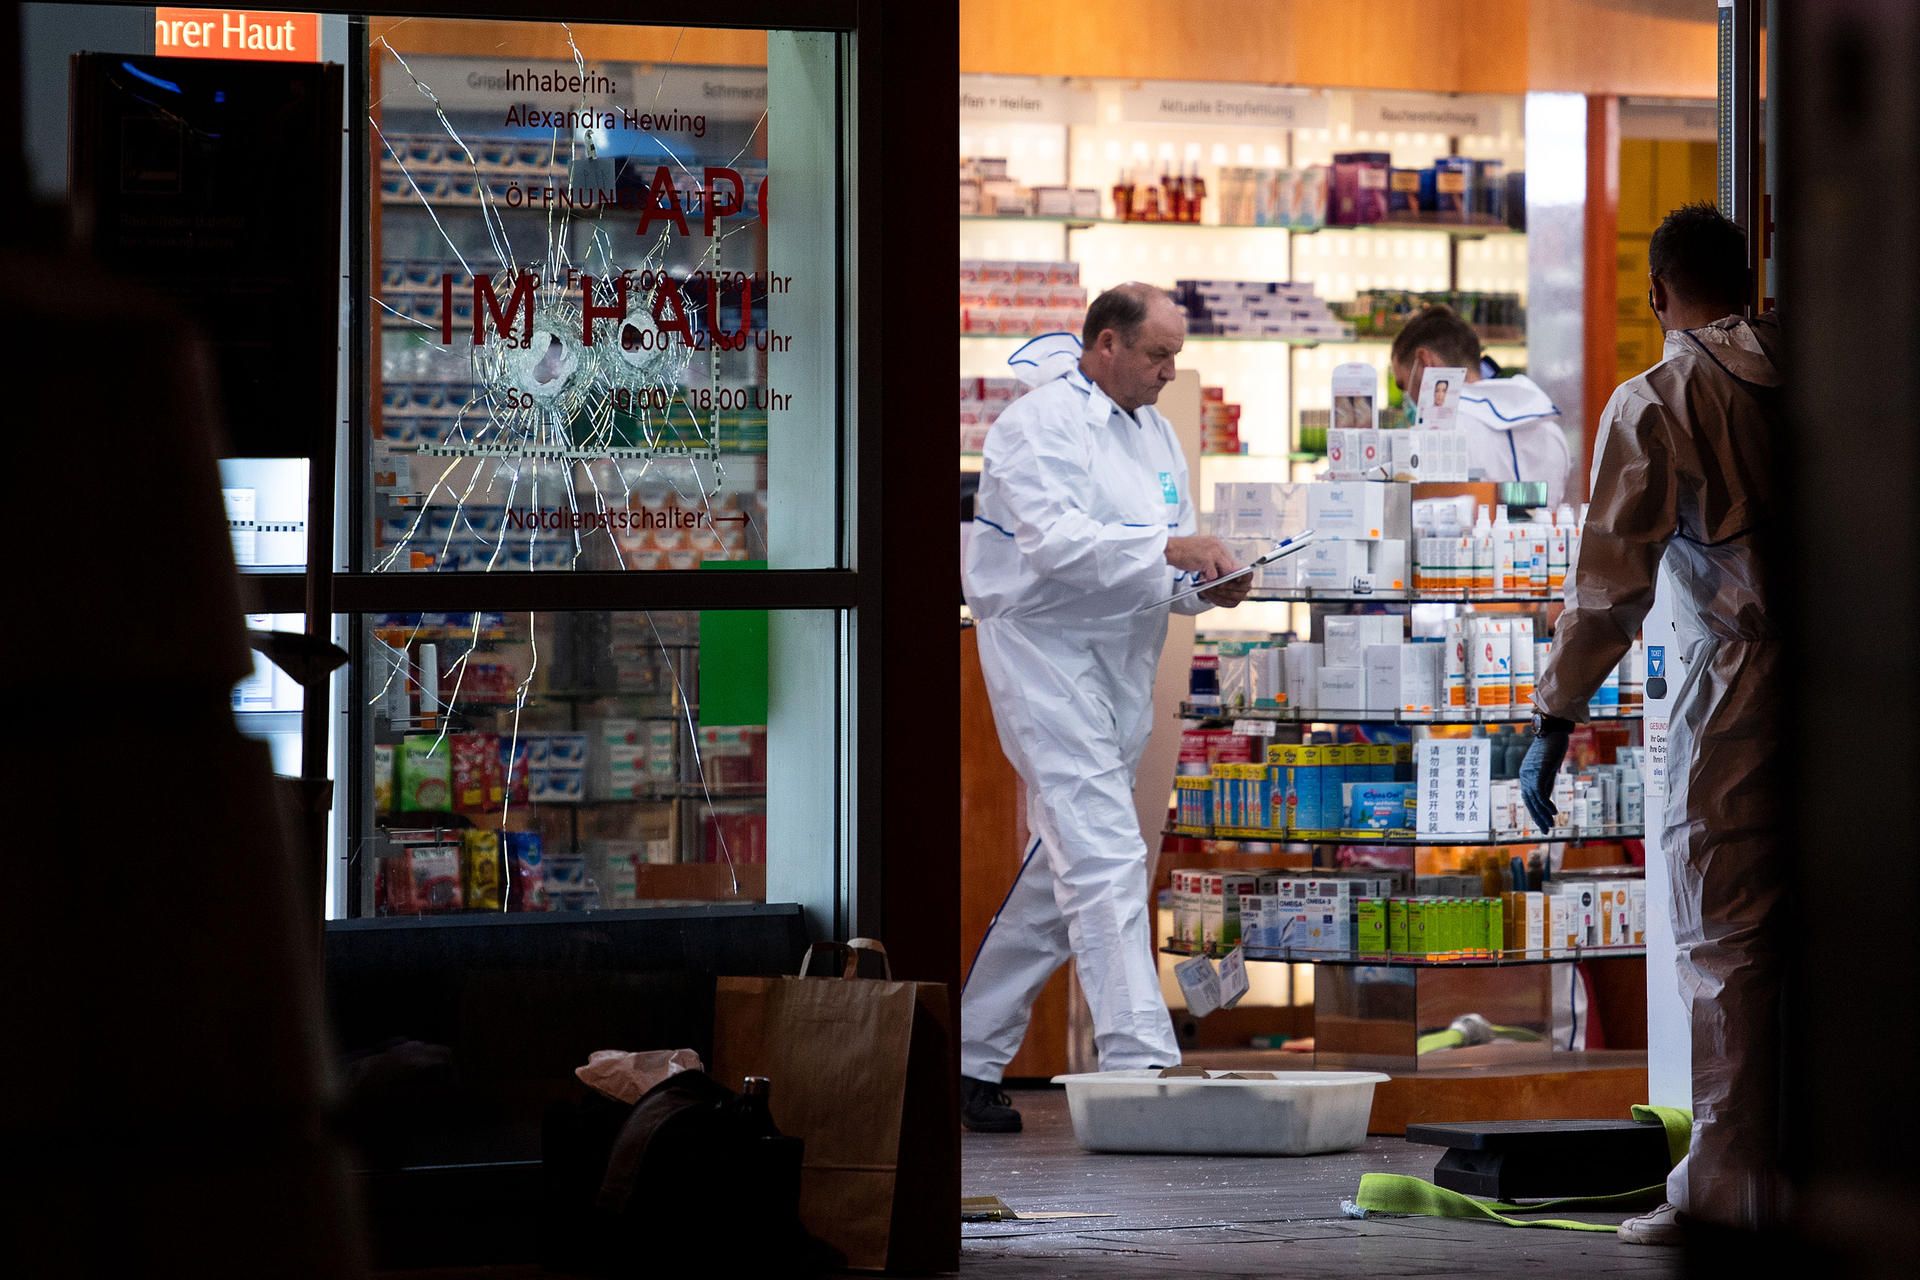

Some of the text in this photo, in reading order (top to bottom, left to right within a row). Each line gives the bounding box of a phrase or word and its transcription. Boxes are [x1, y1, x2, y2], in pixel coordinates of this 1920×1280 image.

[223, 13, 296, 51] Haut
[505, 68, 616, 95] Inhaberin:
[505, 104, 706, 138] Alexandra Hewing
[636, 166, 768, 237] AP
[755, 271, 792, 294] Uhr
[442, 273, 752, 348] IM HAU
[755, 331, 792, 352] Uhr
[506, 387, 533, 411] So
[609, 388, 667, 411] 10.00
[691, 388, 747, 411] 18.00
[754, 388, 792, 411] Uhr
[506, 506, 706, 530] Notdienstschalter
